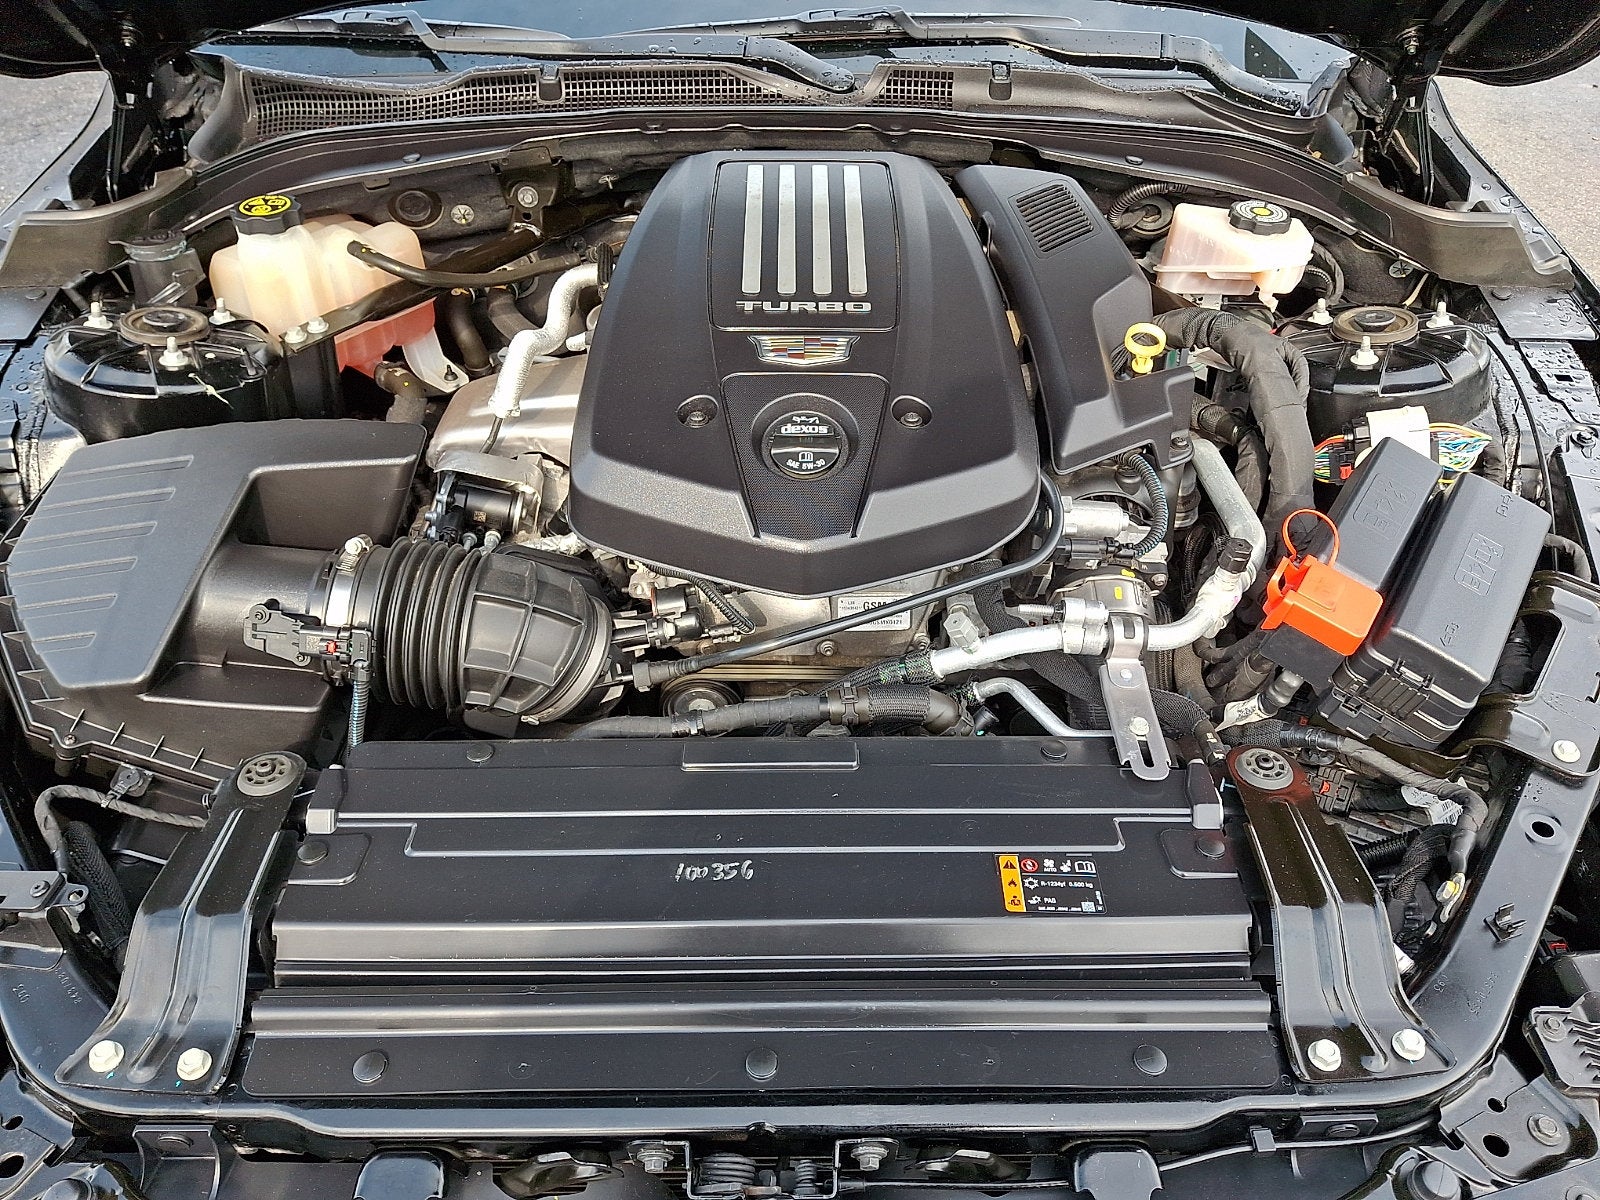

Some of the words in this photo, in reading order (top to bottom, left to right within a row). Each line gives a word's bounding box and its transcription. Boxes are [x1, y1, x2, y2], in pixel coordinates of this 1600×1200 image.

[736, 301, 872, 313] TURBO
[781, 423, 829, 434] dexos
[675, 859, 754, 882] 100356
